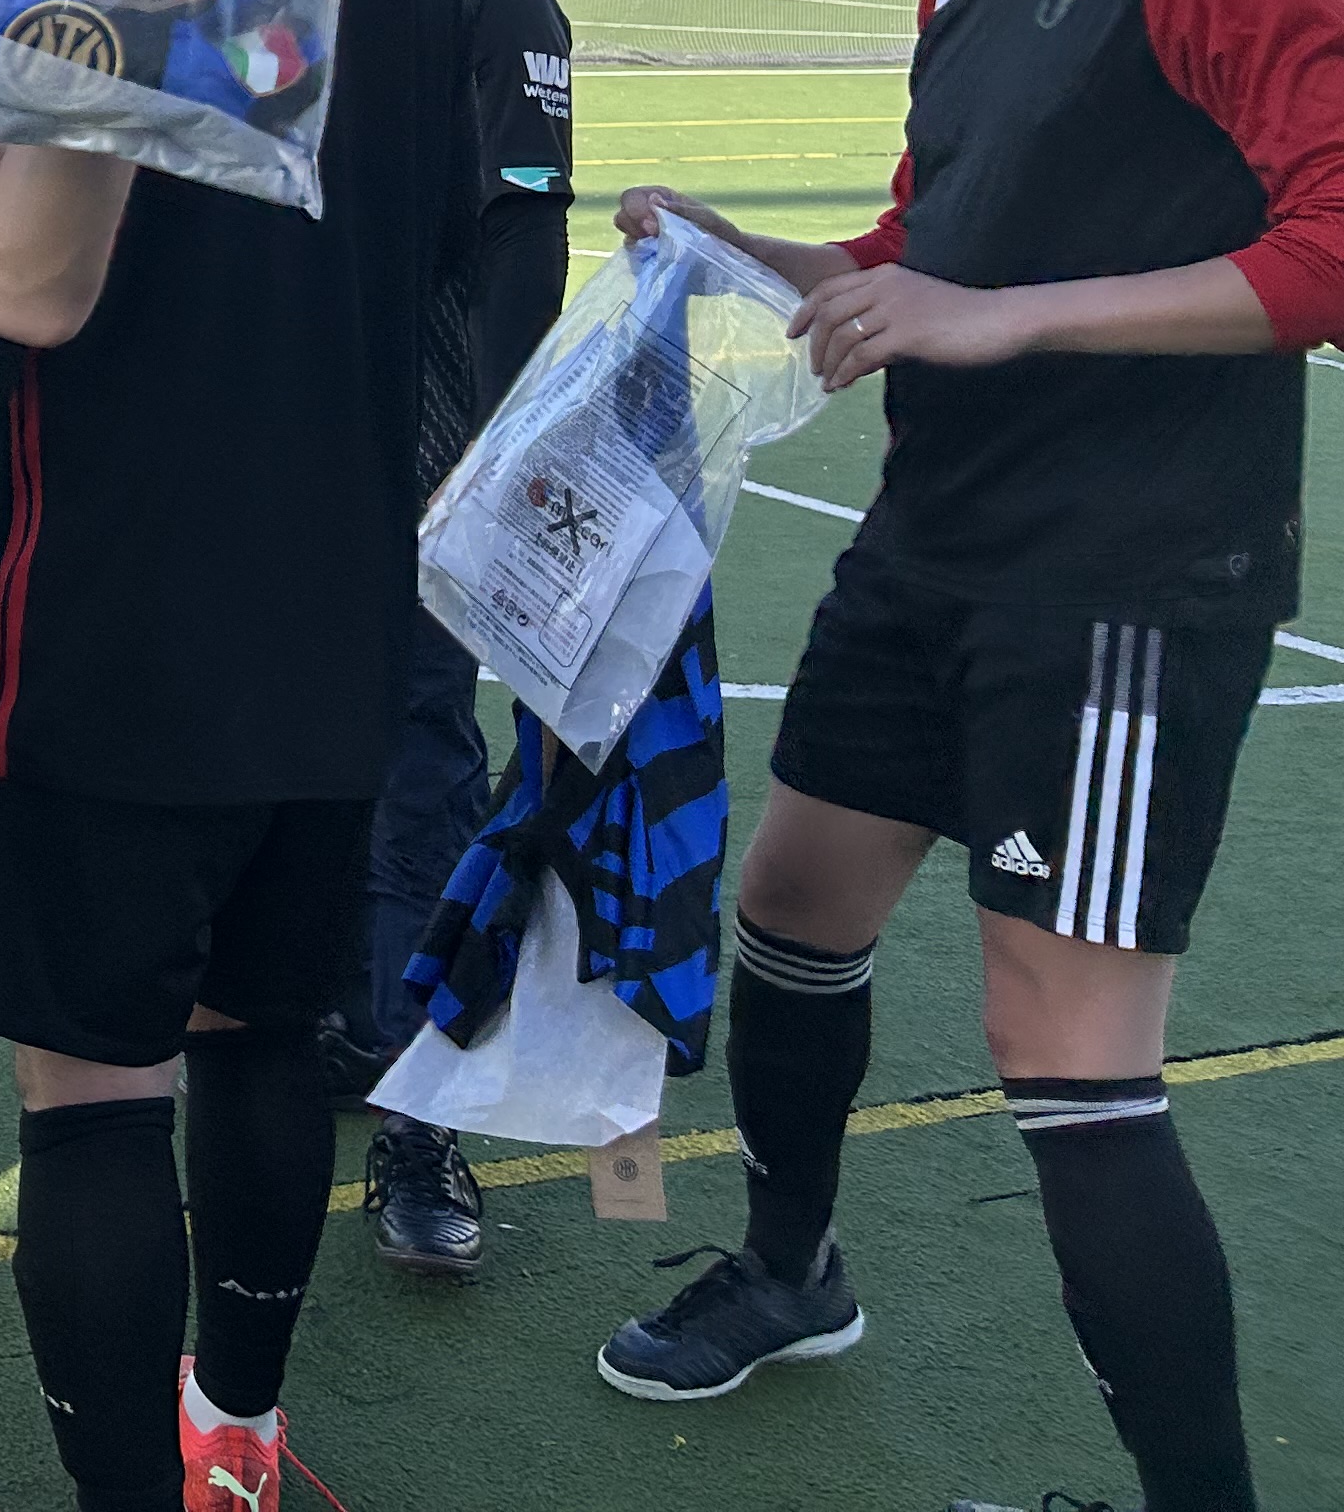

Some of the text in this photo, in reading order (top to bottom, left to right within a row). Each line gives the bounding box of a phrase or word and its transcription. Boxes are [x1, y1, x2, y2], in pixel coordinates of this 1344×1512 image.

[522, 50, 570, 90] WU
[522, 83, 569, 105] Wetern
[550, 500, 616, 558] mcari
[991, 852, 1052, 880] adidas
